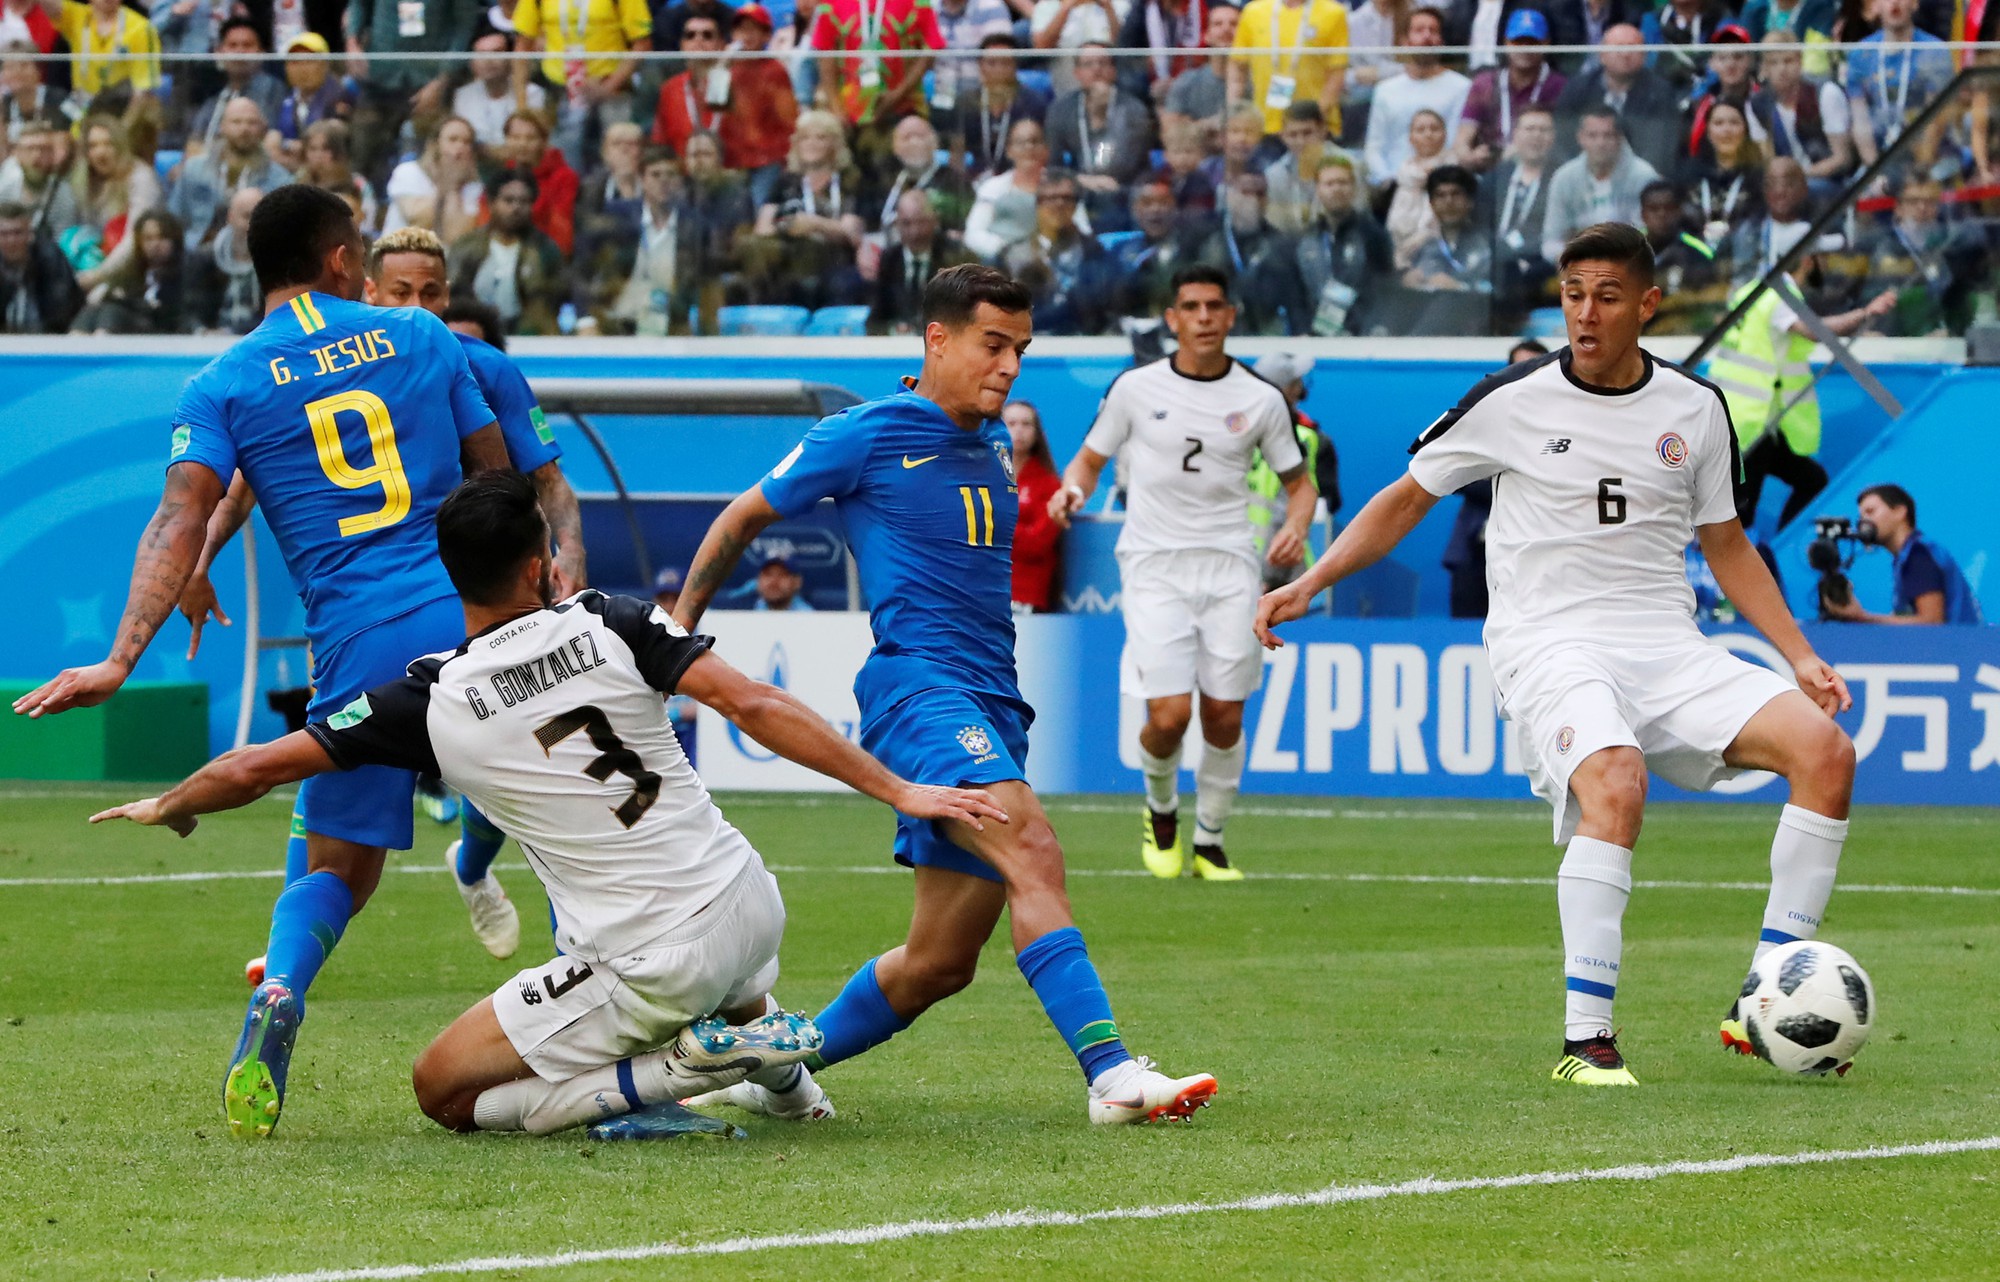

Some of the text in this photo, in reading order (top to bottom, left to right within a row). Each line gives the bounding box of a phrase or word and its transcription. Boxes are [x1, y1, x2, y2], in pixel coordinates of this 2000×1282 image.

[269, 328, 396, 386] G. JESUS
[303, 389, 412, 538] 9
[1182, 437, 1203, 473] 2
[959, 486, 994, 547] 11
[1597, 477, 1627, 525] 6
[489, 620, 540, 649] COSTA RICA
[465, 631, 607, 721] G. GONZALEZ
[1118, 642, 1531, 776] ZPRO
[531, 705, 663, 830] 3
[974, 753, 1000, 765] BRASIL
[1788, 911, 1816, 927] COSTA
[543, 961, 594, 999] 3
[1574, 955, 1607, 969] COSTA
